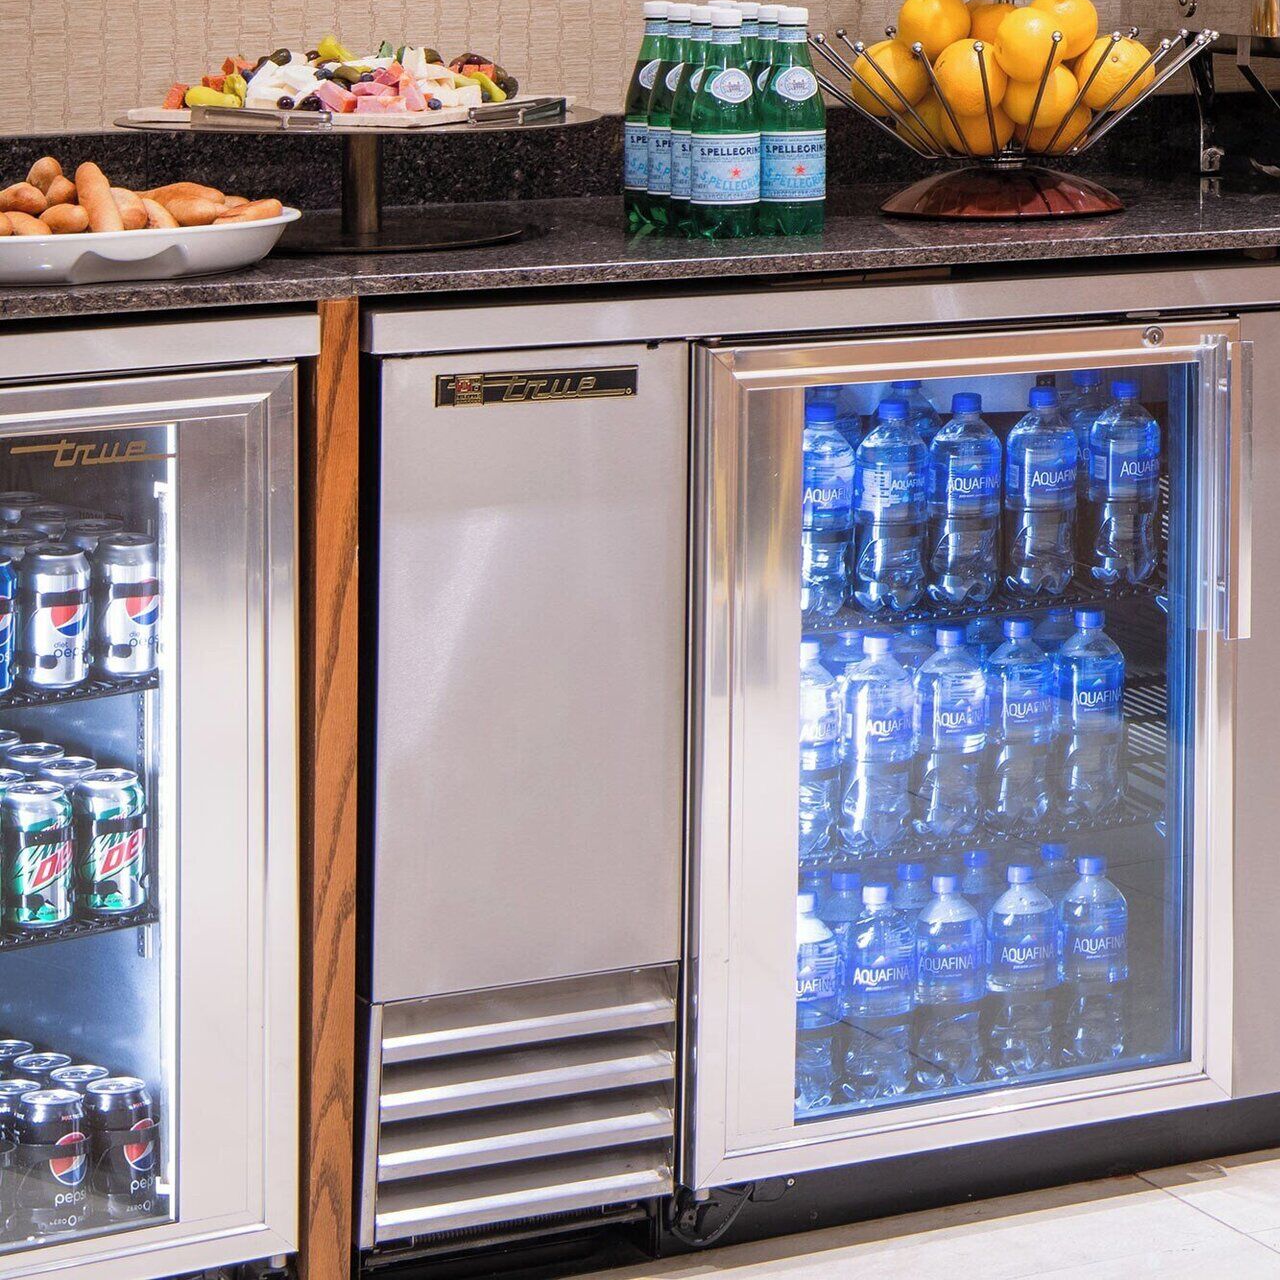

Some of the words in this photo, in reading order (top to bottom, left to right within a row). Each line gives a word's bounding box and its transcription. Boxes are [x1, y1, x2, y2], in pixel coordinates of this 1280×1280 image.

[700, 146, 759, 157] S.PELLEGRIN
[766, 143, 825, 154] S.PELLEGRIN
[484, 376, 600, 402] true
[10, 439, 150, 467] true
[1031, 467, 1076, 487] AQUAFIN
[1001, 944, 1054, 964] AQUAFINA
[1073, 934, 1127, 954] AQUAFINA
[918, 954, 973, 974] AQUAFINA
[853, 966, 911, 986] AQUAFINA
[55, 1190, 86, 1207] peps
